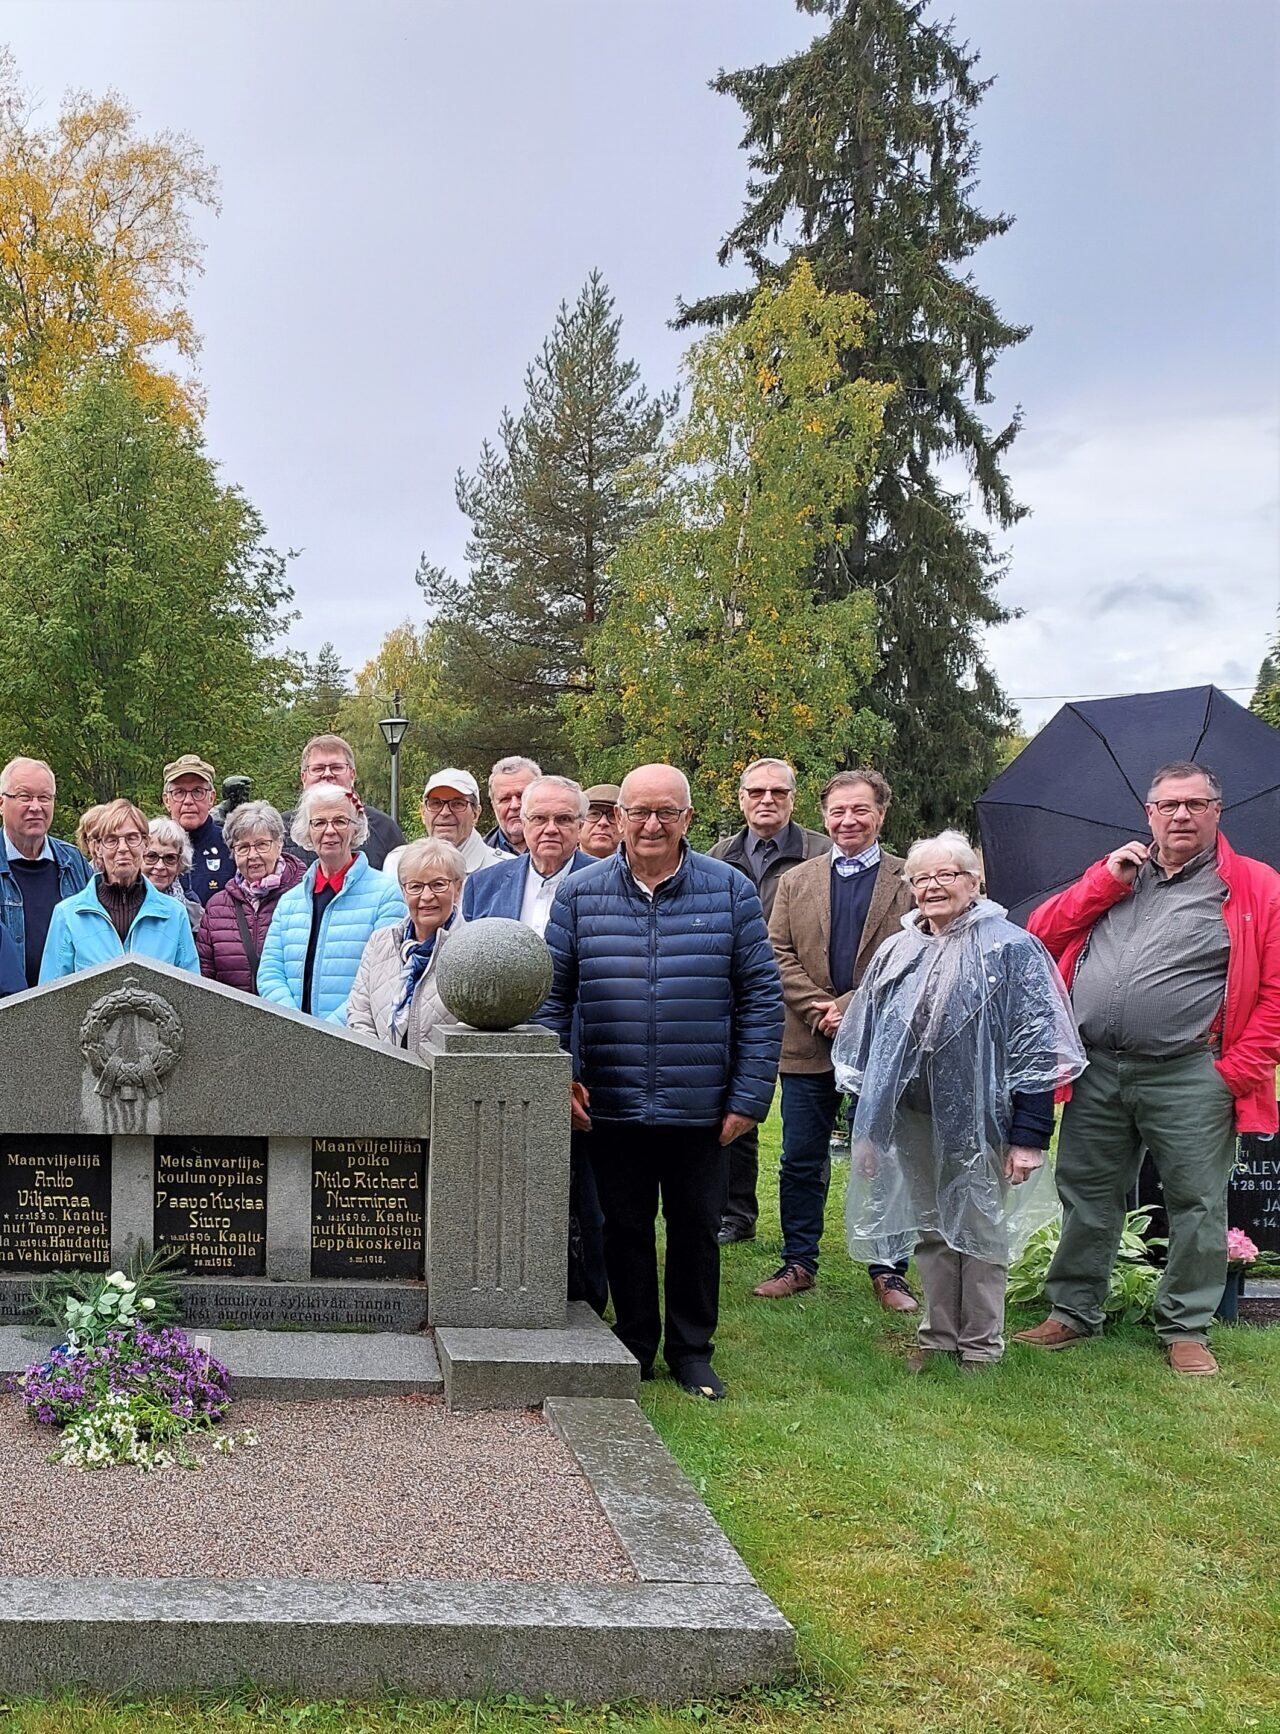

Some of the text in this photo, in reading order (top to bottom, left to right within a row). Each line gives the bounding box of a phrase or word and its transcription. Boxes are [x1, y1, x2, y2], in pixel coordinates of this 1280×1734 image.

[315, 1139, 422, 1155] Maanviljelijän
[7, 1153, 100, 1169] Maanviljelijä
[160, 1155, 265, 1171] Metsänvartija-
[348, 1154, 390, 1168] poika
[157, 1170, 263, 1187] koulun oppilas
[314, 1171, 419, 1189] Niilo Richard
[17, 1190, 91, 1213] Viljamaa
[156, 1191, 264, 1212] Paavo Kustaa
[326, 1190, 408, 1208] Nurminen
[63, 1209, 108, 1221] Kaatu-
[189, 1211, 231, 1228] Siuro
[375, 1210, 422, 1223] Kaatu-
[3, 1222, 108, 1237] nut Tampereel-
[219, 1230, 265, 1243] Kaatu-
[312, 1223, 422, 1237] nut Kuhmoisten
[50, 1236, 111, 1249] Haudattu-
[190, 1243, 256, 1256] Hauholla
[312, 1236, 421, 1251] Leppäkoskella
[18, 1249, 110, 1264] Vehkajärvellä
